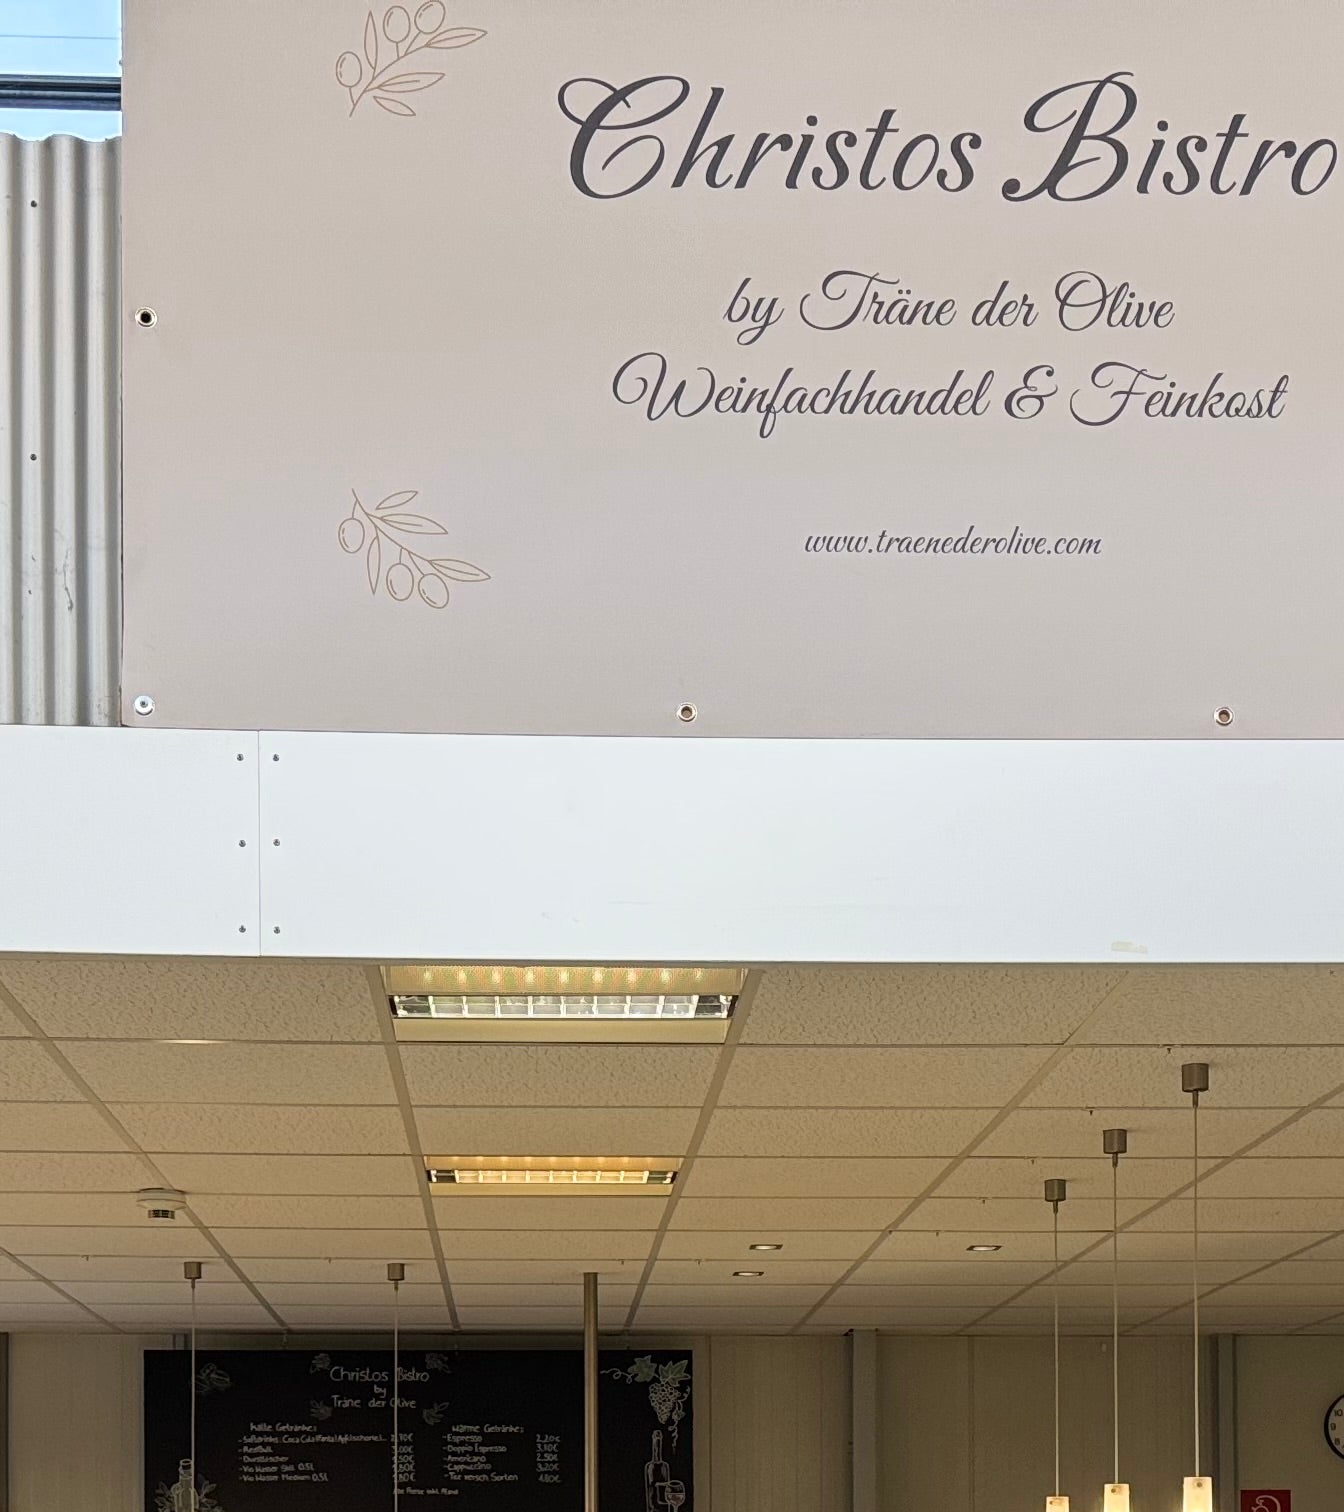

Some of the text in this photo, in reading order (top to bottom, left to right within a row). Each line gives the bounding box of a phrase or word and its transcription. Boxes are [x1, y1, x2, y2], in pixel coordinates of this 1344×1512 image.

[558, 71, 1338, 203] Christos Bistro
[722, 270, 1176, 346] by Träne der Olive
[612, 351, 1289, 439] Weinfachhandel & Feinkost
[804, 525, 1103, 555] www.traenederolive.com
[329, 1366, 430, 1383] Christos Bistro
[367, 1396, 387, 1409] der
[373, 1384, 387, 1399] by
